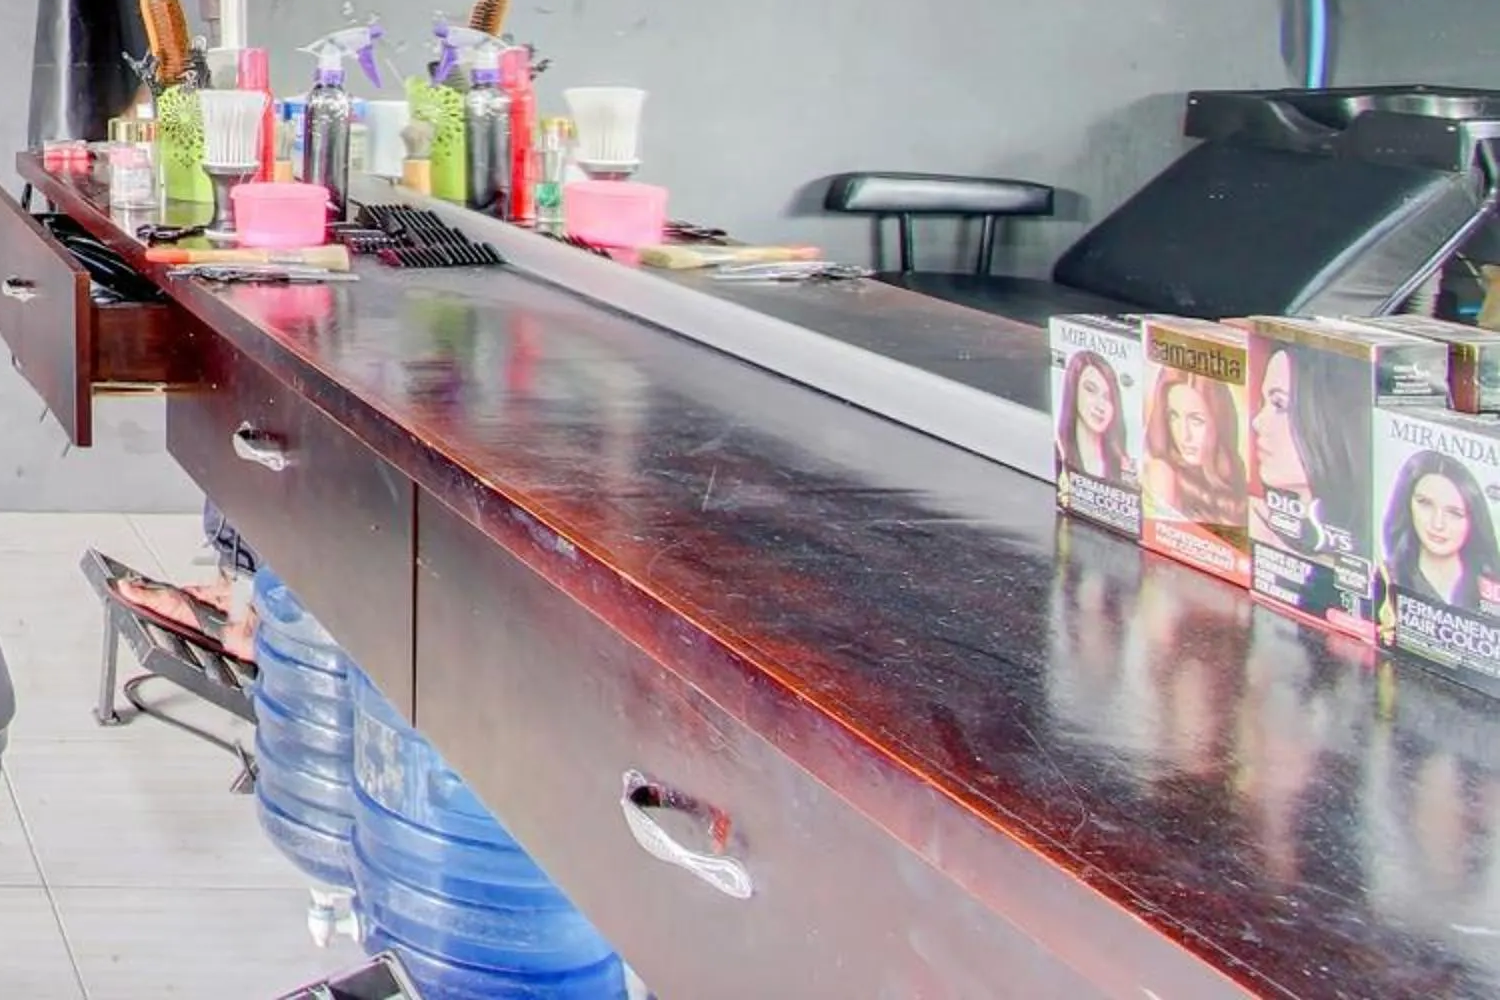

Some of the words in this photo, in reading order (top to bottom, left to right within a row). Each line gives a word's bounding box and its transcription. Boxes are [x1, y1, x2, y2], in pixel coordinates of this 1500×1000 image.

[1060, 327, 1127, 360] MIRANDA
[1152, 339, 1240, 378] samantha
[1390, 420, 1499, 467] MIRANDA
